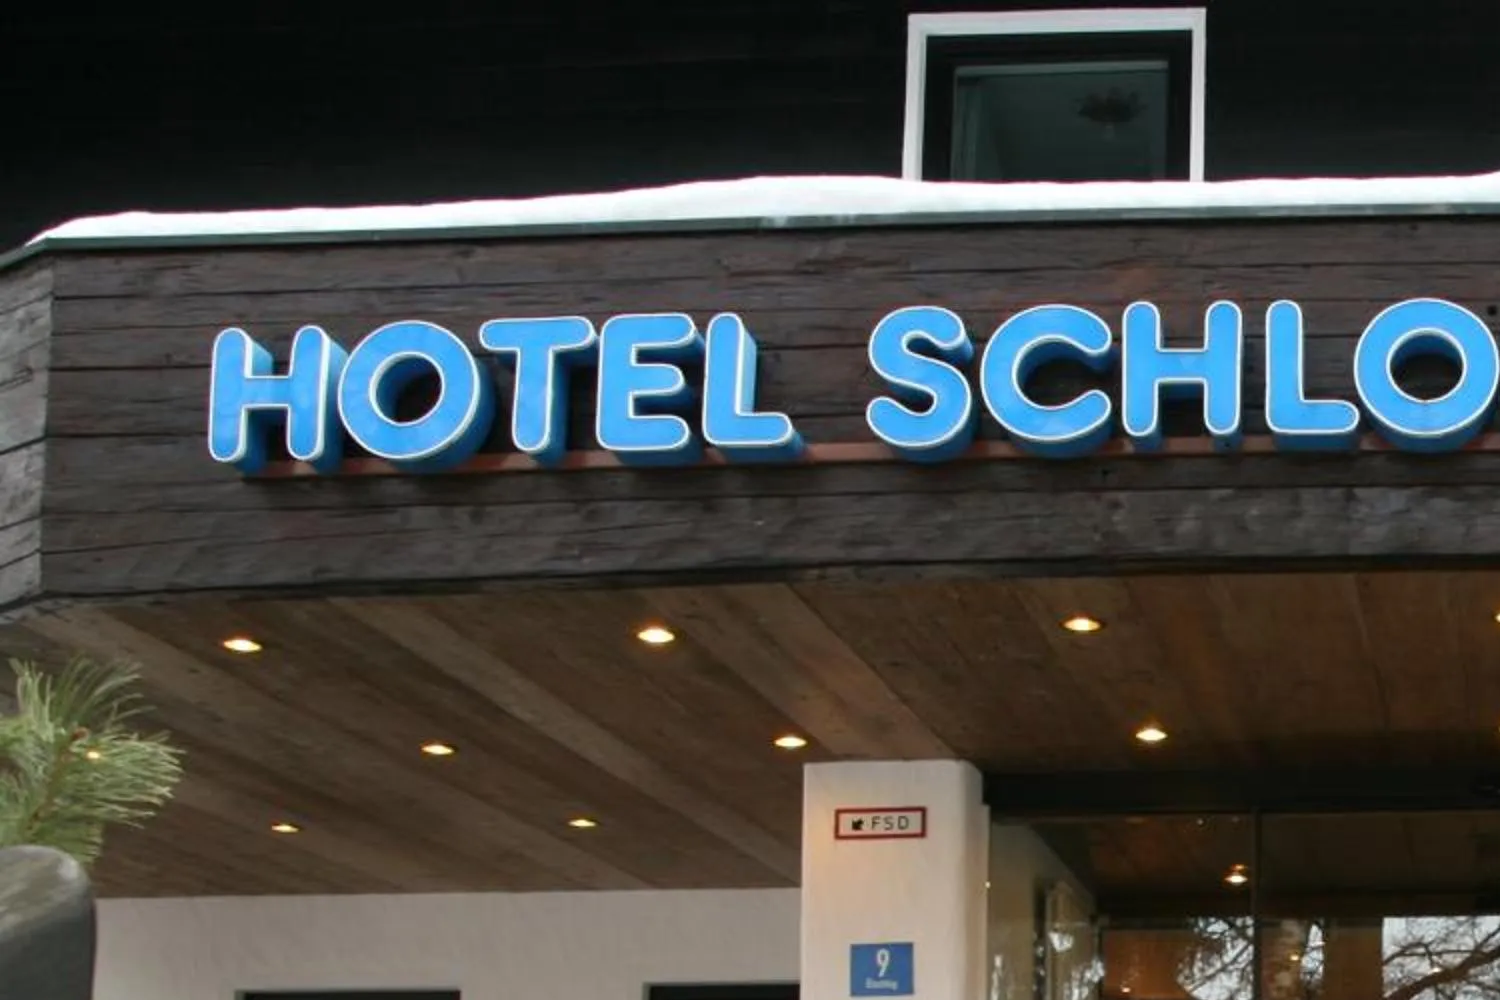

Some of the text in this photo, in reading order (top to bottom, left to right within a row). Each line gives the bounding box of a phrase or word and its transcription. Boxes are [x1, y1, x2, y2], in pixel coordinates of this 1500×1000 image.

[208, 312, 798, 466] HOTEL
[871, 815, 909, 831] FSD
[876, 948, 889, 978] 9
